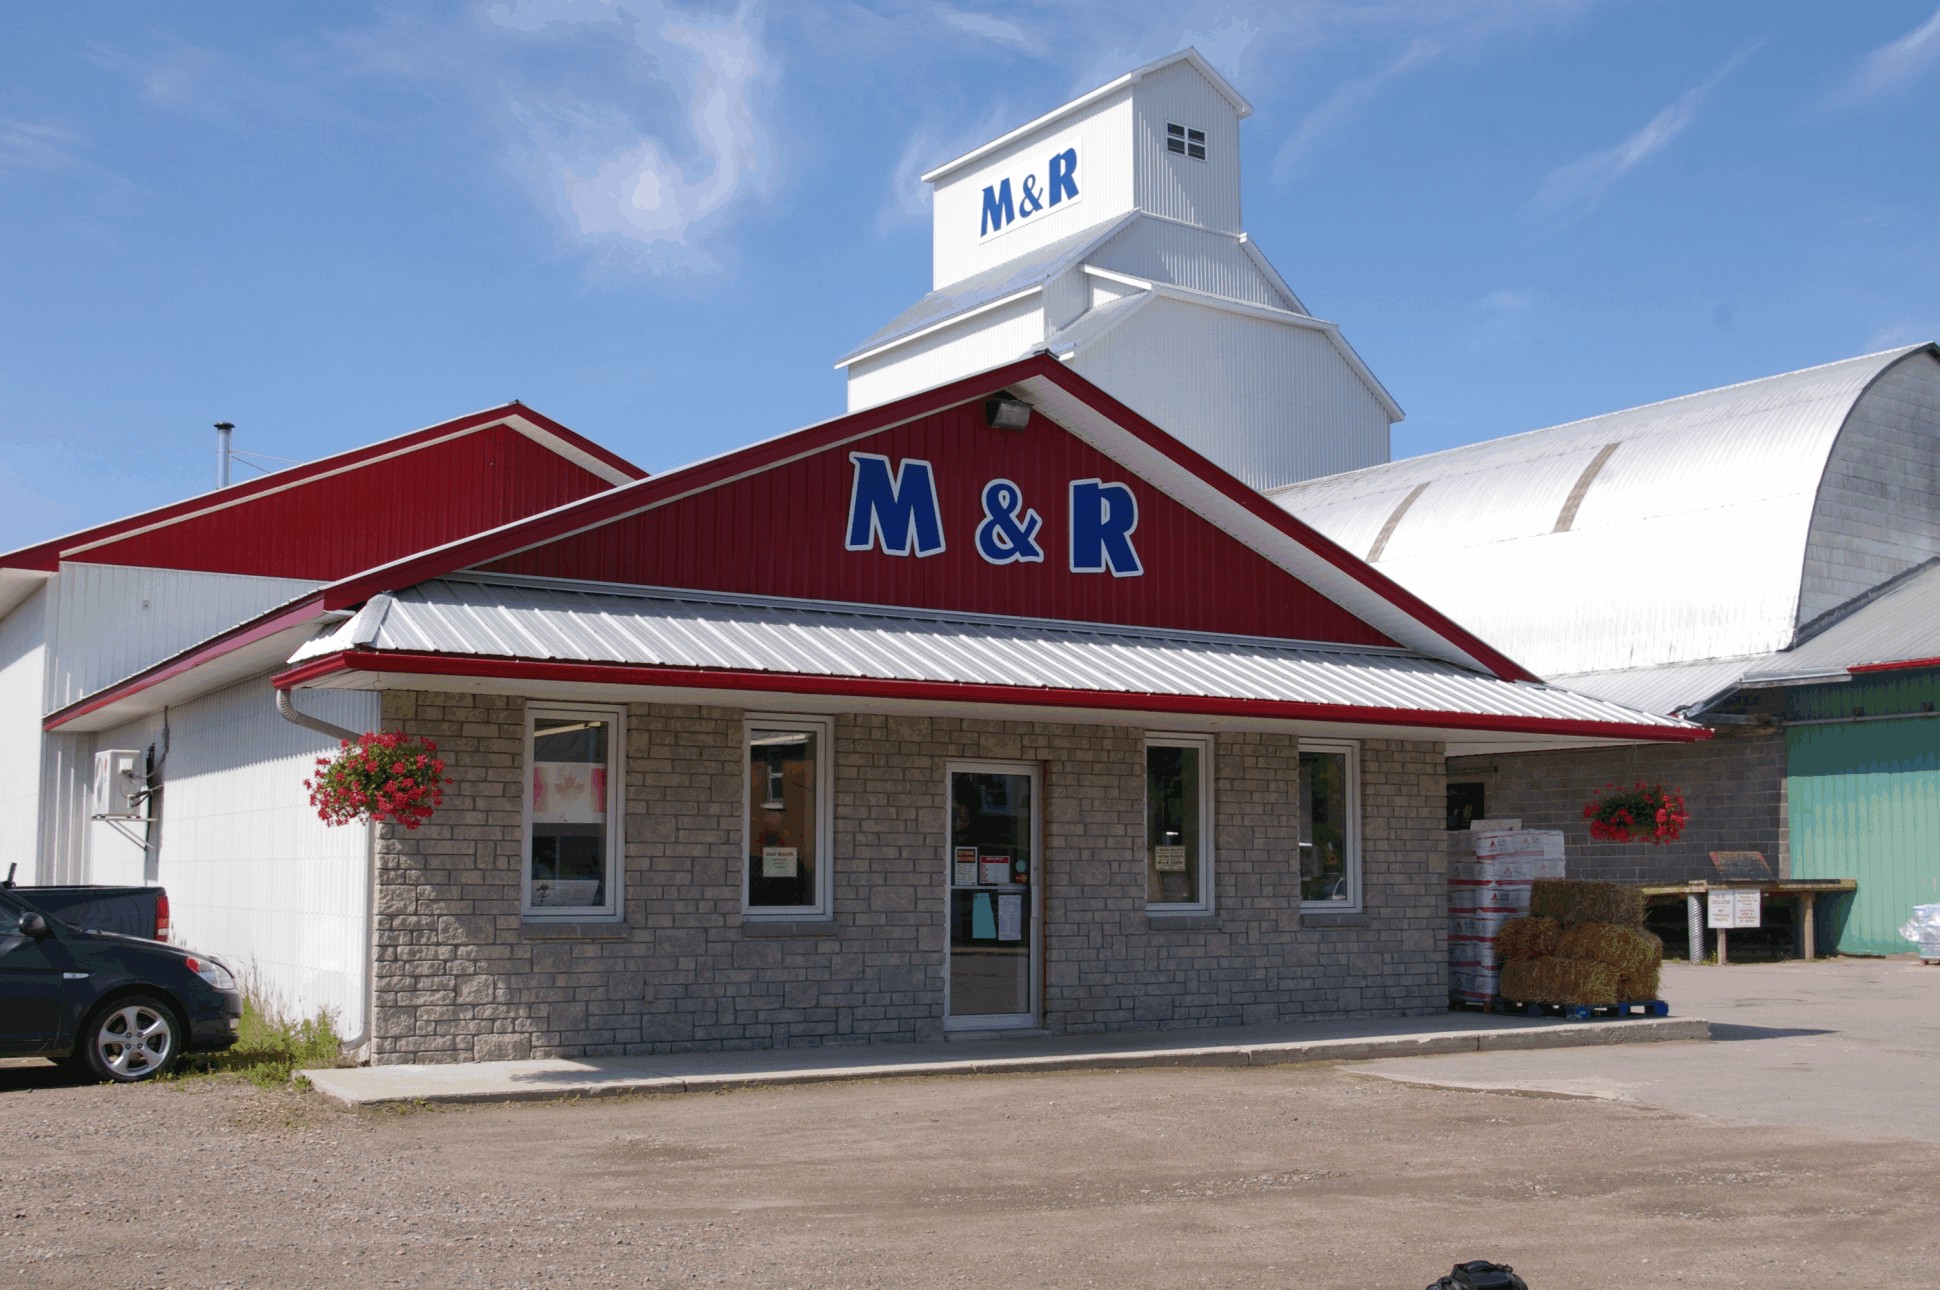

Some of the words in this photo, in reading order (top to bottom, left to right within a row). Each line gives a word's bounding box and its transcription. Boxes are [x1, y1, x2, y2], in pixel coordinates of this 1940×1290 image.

[845, 451, 946, 558] M
[975, 478, 1044, 565] &
[1069, 477, 1144, 578] R
